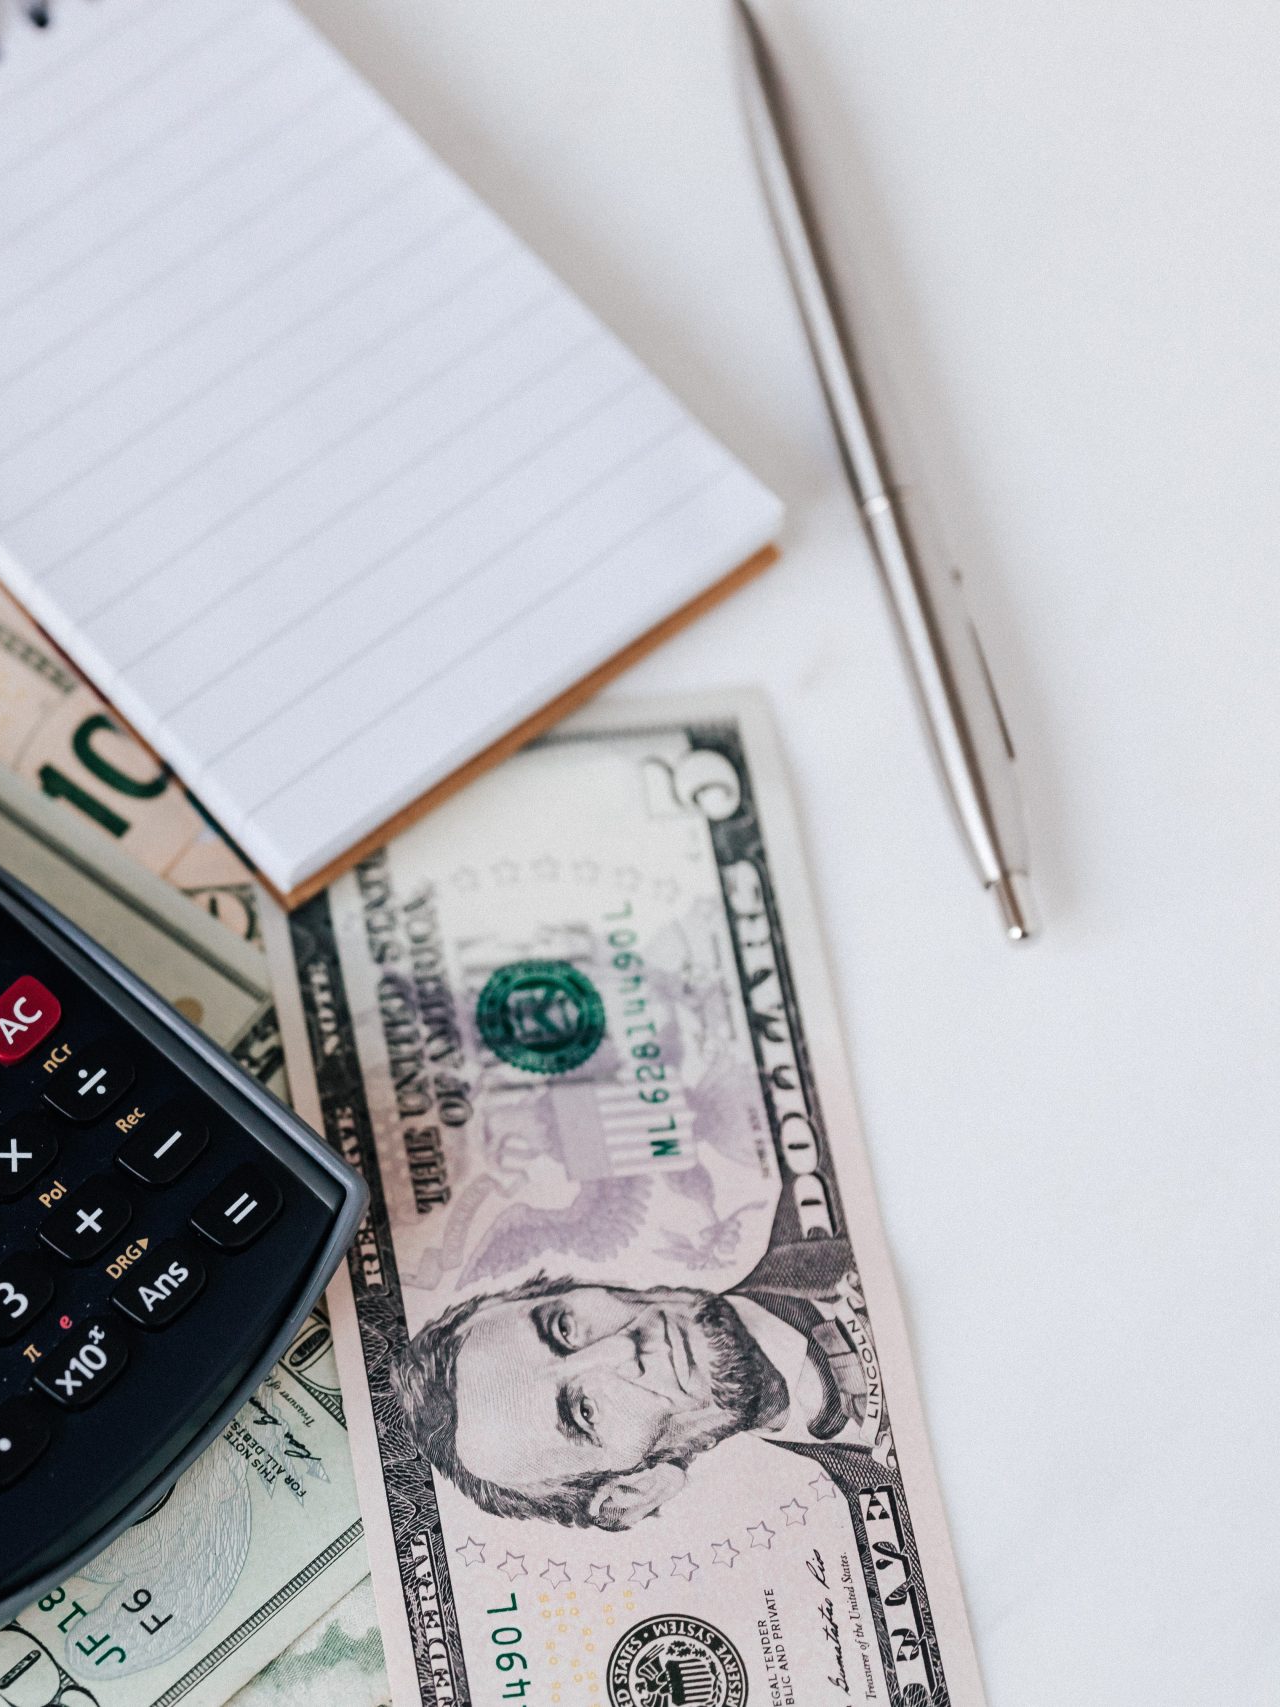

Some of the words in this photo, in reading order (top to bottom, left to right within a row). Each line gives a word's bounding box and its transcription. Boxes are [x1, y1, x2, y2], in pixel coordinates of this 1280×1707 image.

[38, 711, 173, 840] 10
[42, 1041, 74, 1075] nCr
[720, 856, 842, 1242] DOLLARS
[433, 1072, 475, 1129] OF
[115, 1106, 147, 1135] Rec
[647, 1111, 683, 1159] ML
[403, 1125, 452, 1215] THE
[38, 1180, 68, 1209] Pol
[136, 1259, 190, 1313] Ans
[846, 1319, 881, 1420] LINCOLN
[278, 1390, 317, 1429] Treasurer
[222, 1430, 252, 1460] NOTE
[250, 1457, 277, 1486] THIS
[266, 1453, 287, 1475] ALL
[283, 1474, 308, 1500] FOR
[486, 1592, 519, 1615] L
[845, 1584, 862, 1622] United
[858, 1484, 938, 1699] FIVE
[763, 1587, 785, 1642] PRIVATE
[853, 1621, 865, 1639] the
[74, 1633, 128, 1667] JF
[651, 1619, 716, 1647] SYSTEM
[756, 1619, 775, 1672] TENDER
[858, 1636, 871, 1653] of
[612, 1635, 644, 1687] STATES
[775, 1644, 790, 1672] AND
[767, 1673, 783, 1707] EGAL
[780, 1675, 796, 1707] BLIC
[858, 1650, 877, 1702] Treasurer
